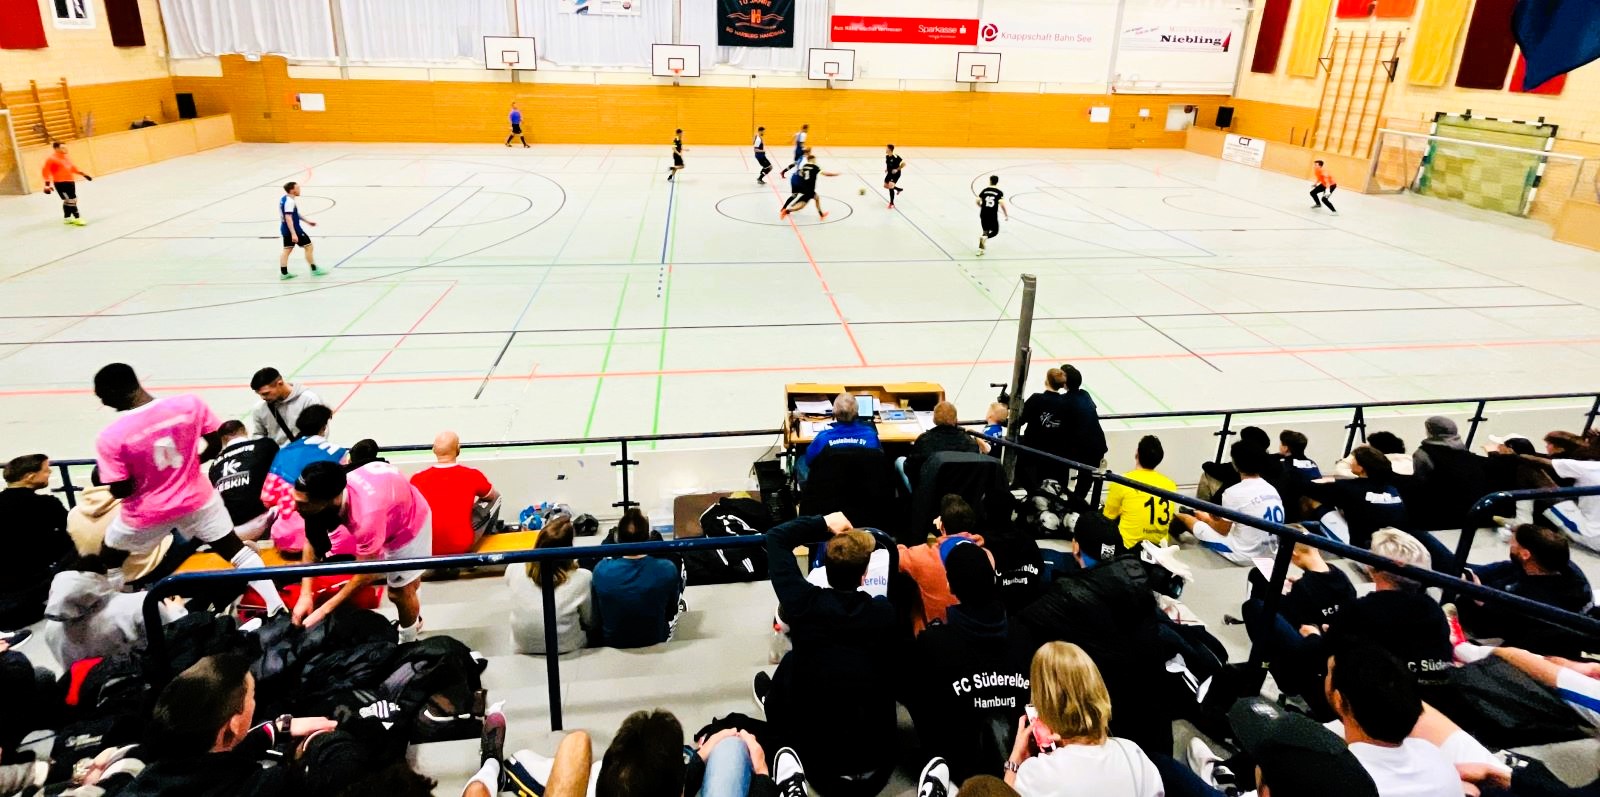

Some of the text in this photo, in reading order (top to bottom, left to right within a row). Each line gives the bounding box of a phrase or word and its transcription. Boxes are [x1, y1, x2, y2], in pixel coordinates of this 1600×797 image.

[918, 24, 957, 34] Sparkasse
[1001, 32, 1092, 43] Knappschaft Bahn See
[1160, 34, 1222, 46] Niebling
[984, 195, 995, 208] 15
[217, 475, 250, 492] ESKIN
[1144, 496, 1169, 525] 13
[952, 671, 1030, 696] FC Süderelbe
[974, 695, 1016, 709] Hamburg
